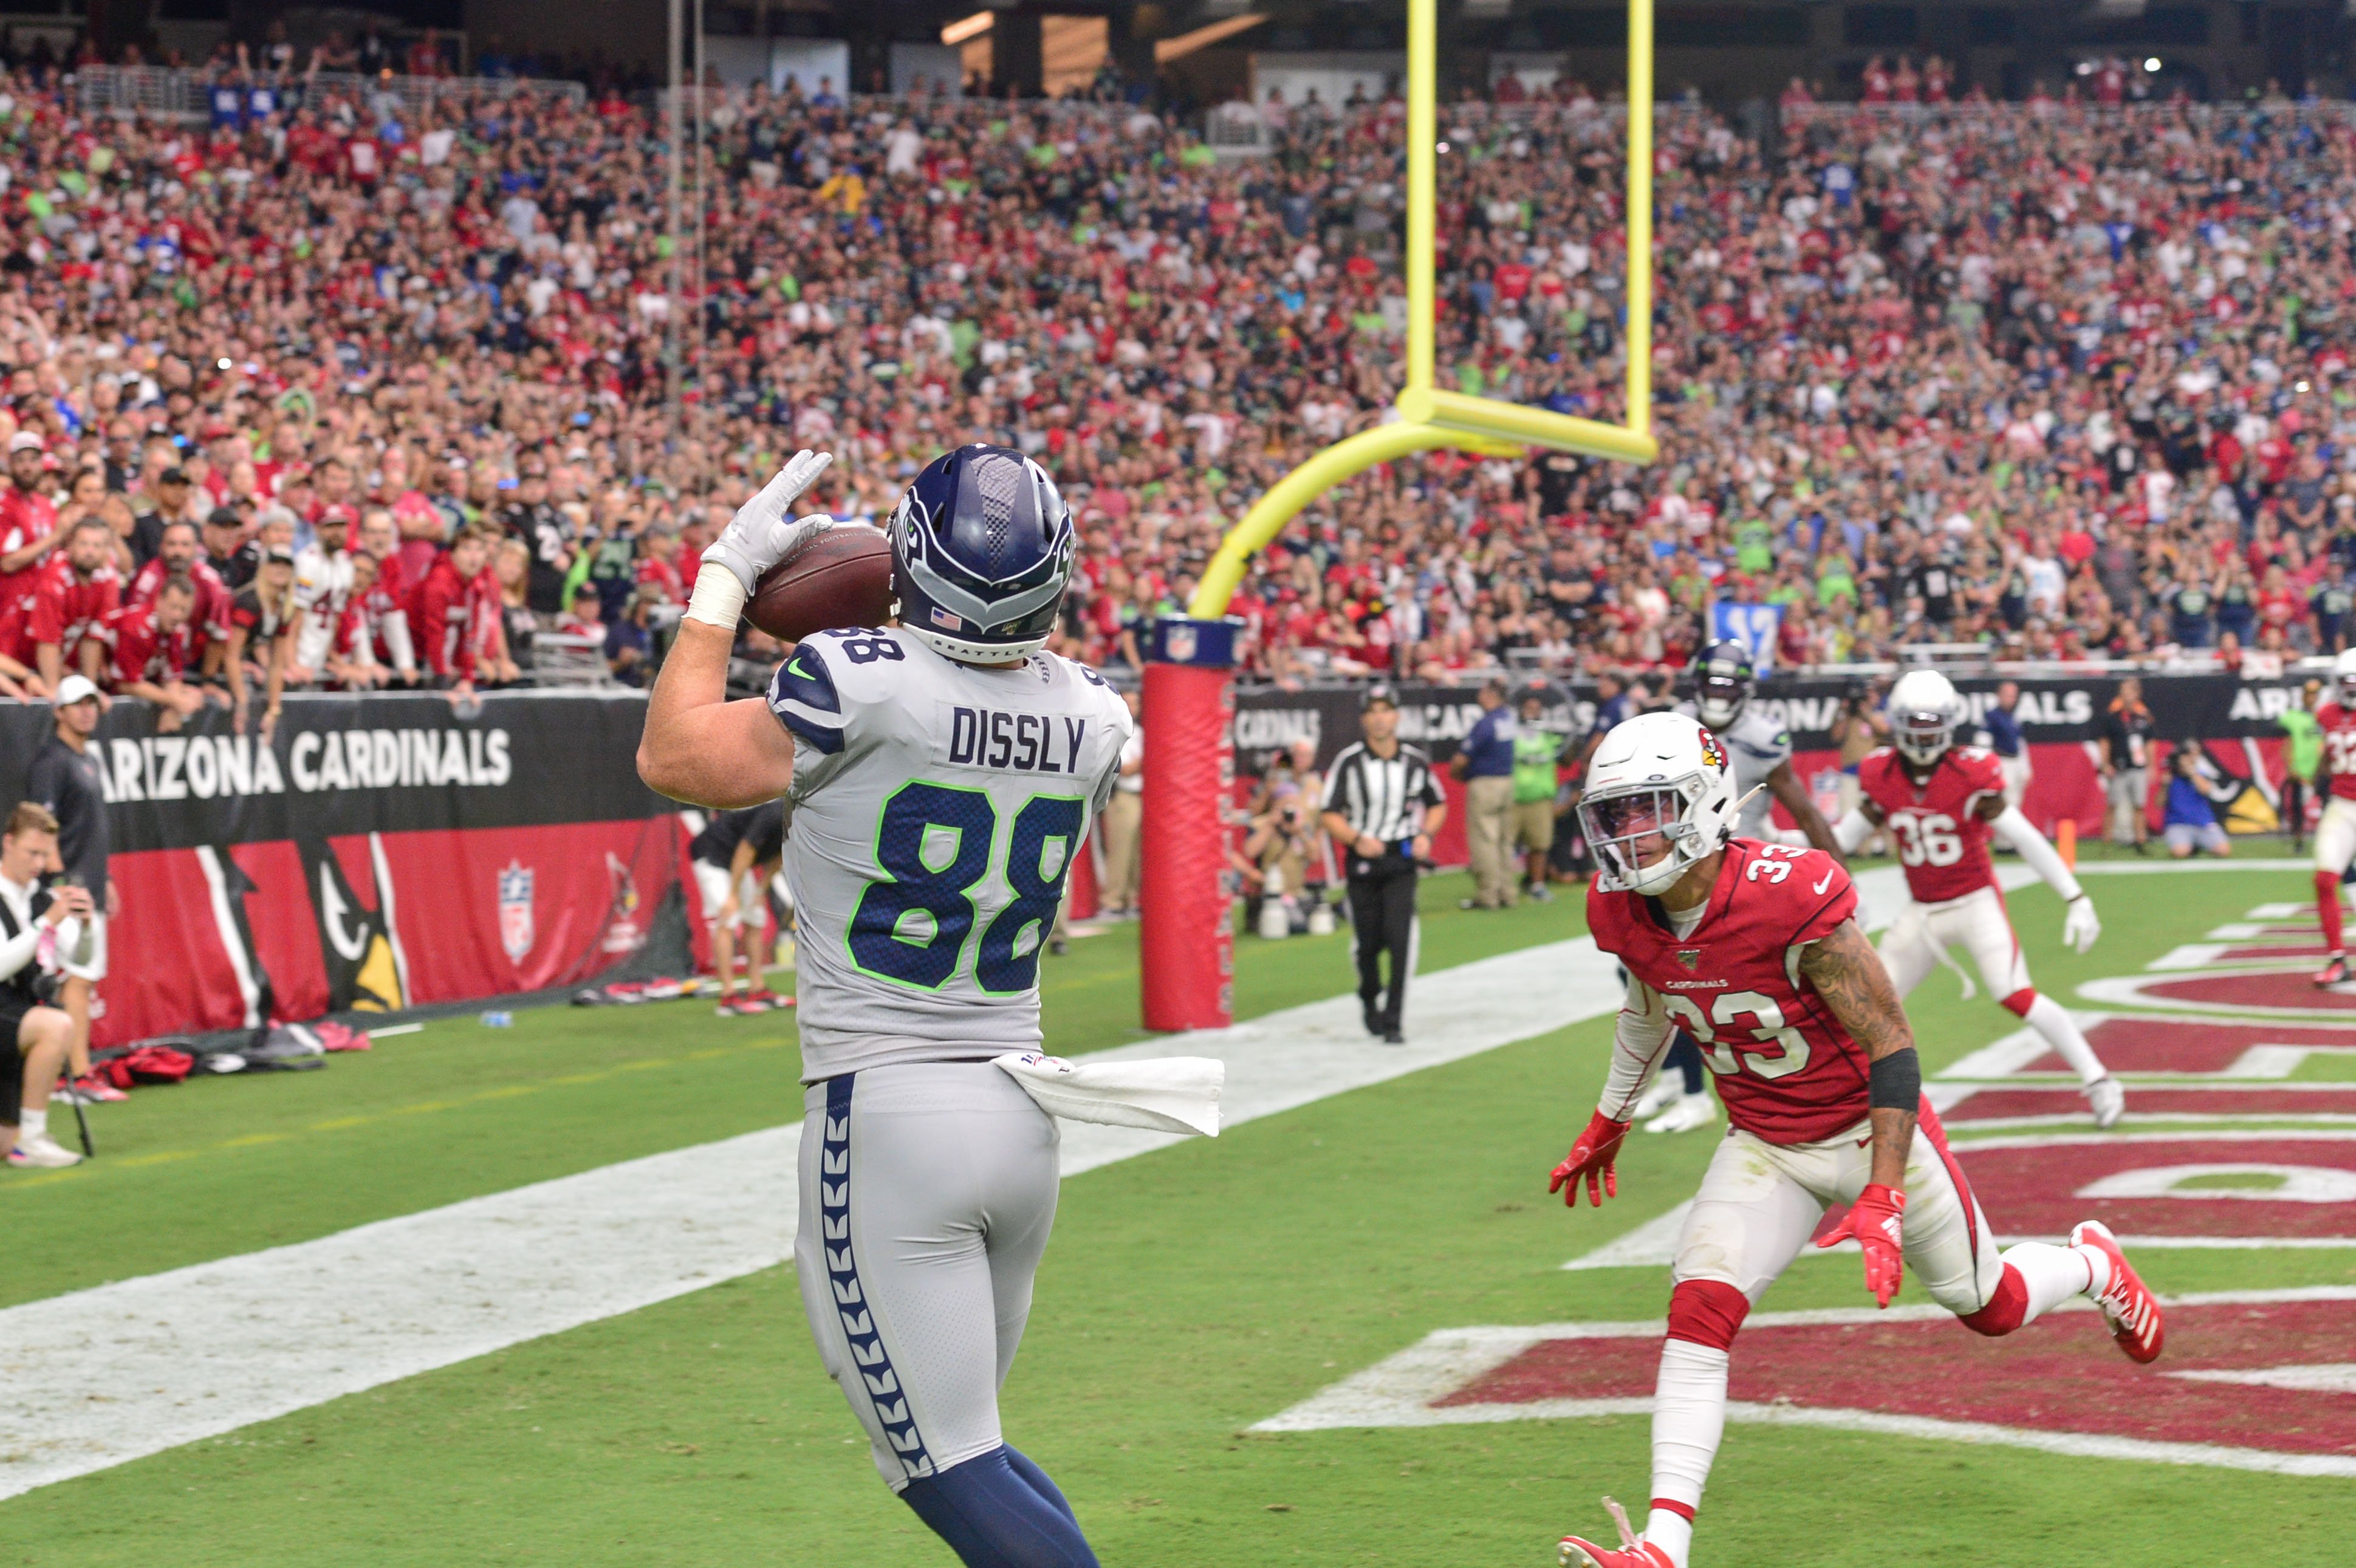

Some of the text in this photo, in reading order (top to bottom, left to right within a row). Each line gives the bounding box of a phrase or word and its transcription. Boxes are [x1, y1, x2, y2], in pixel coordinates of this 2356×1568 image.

[820, 532, 858, 544] FOOTBALL
[934, 640, 1025, 657] SEATTLE
[290, 728, 513, 792] CARDINALS
[949, 706, 1086, 774] DISSLY
[1745, 844, 1809, 885] 33
[1888, 812, 1965, 868] 36
[843, 777, 1086, 998] 88
[1665, 979, 1729, 990] CARDINALS
[1657, 990, 1812, 1081] 33
